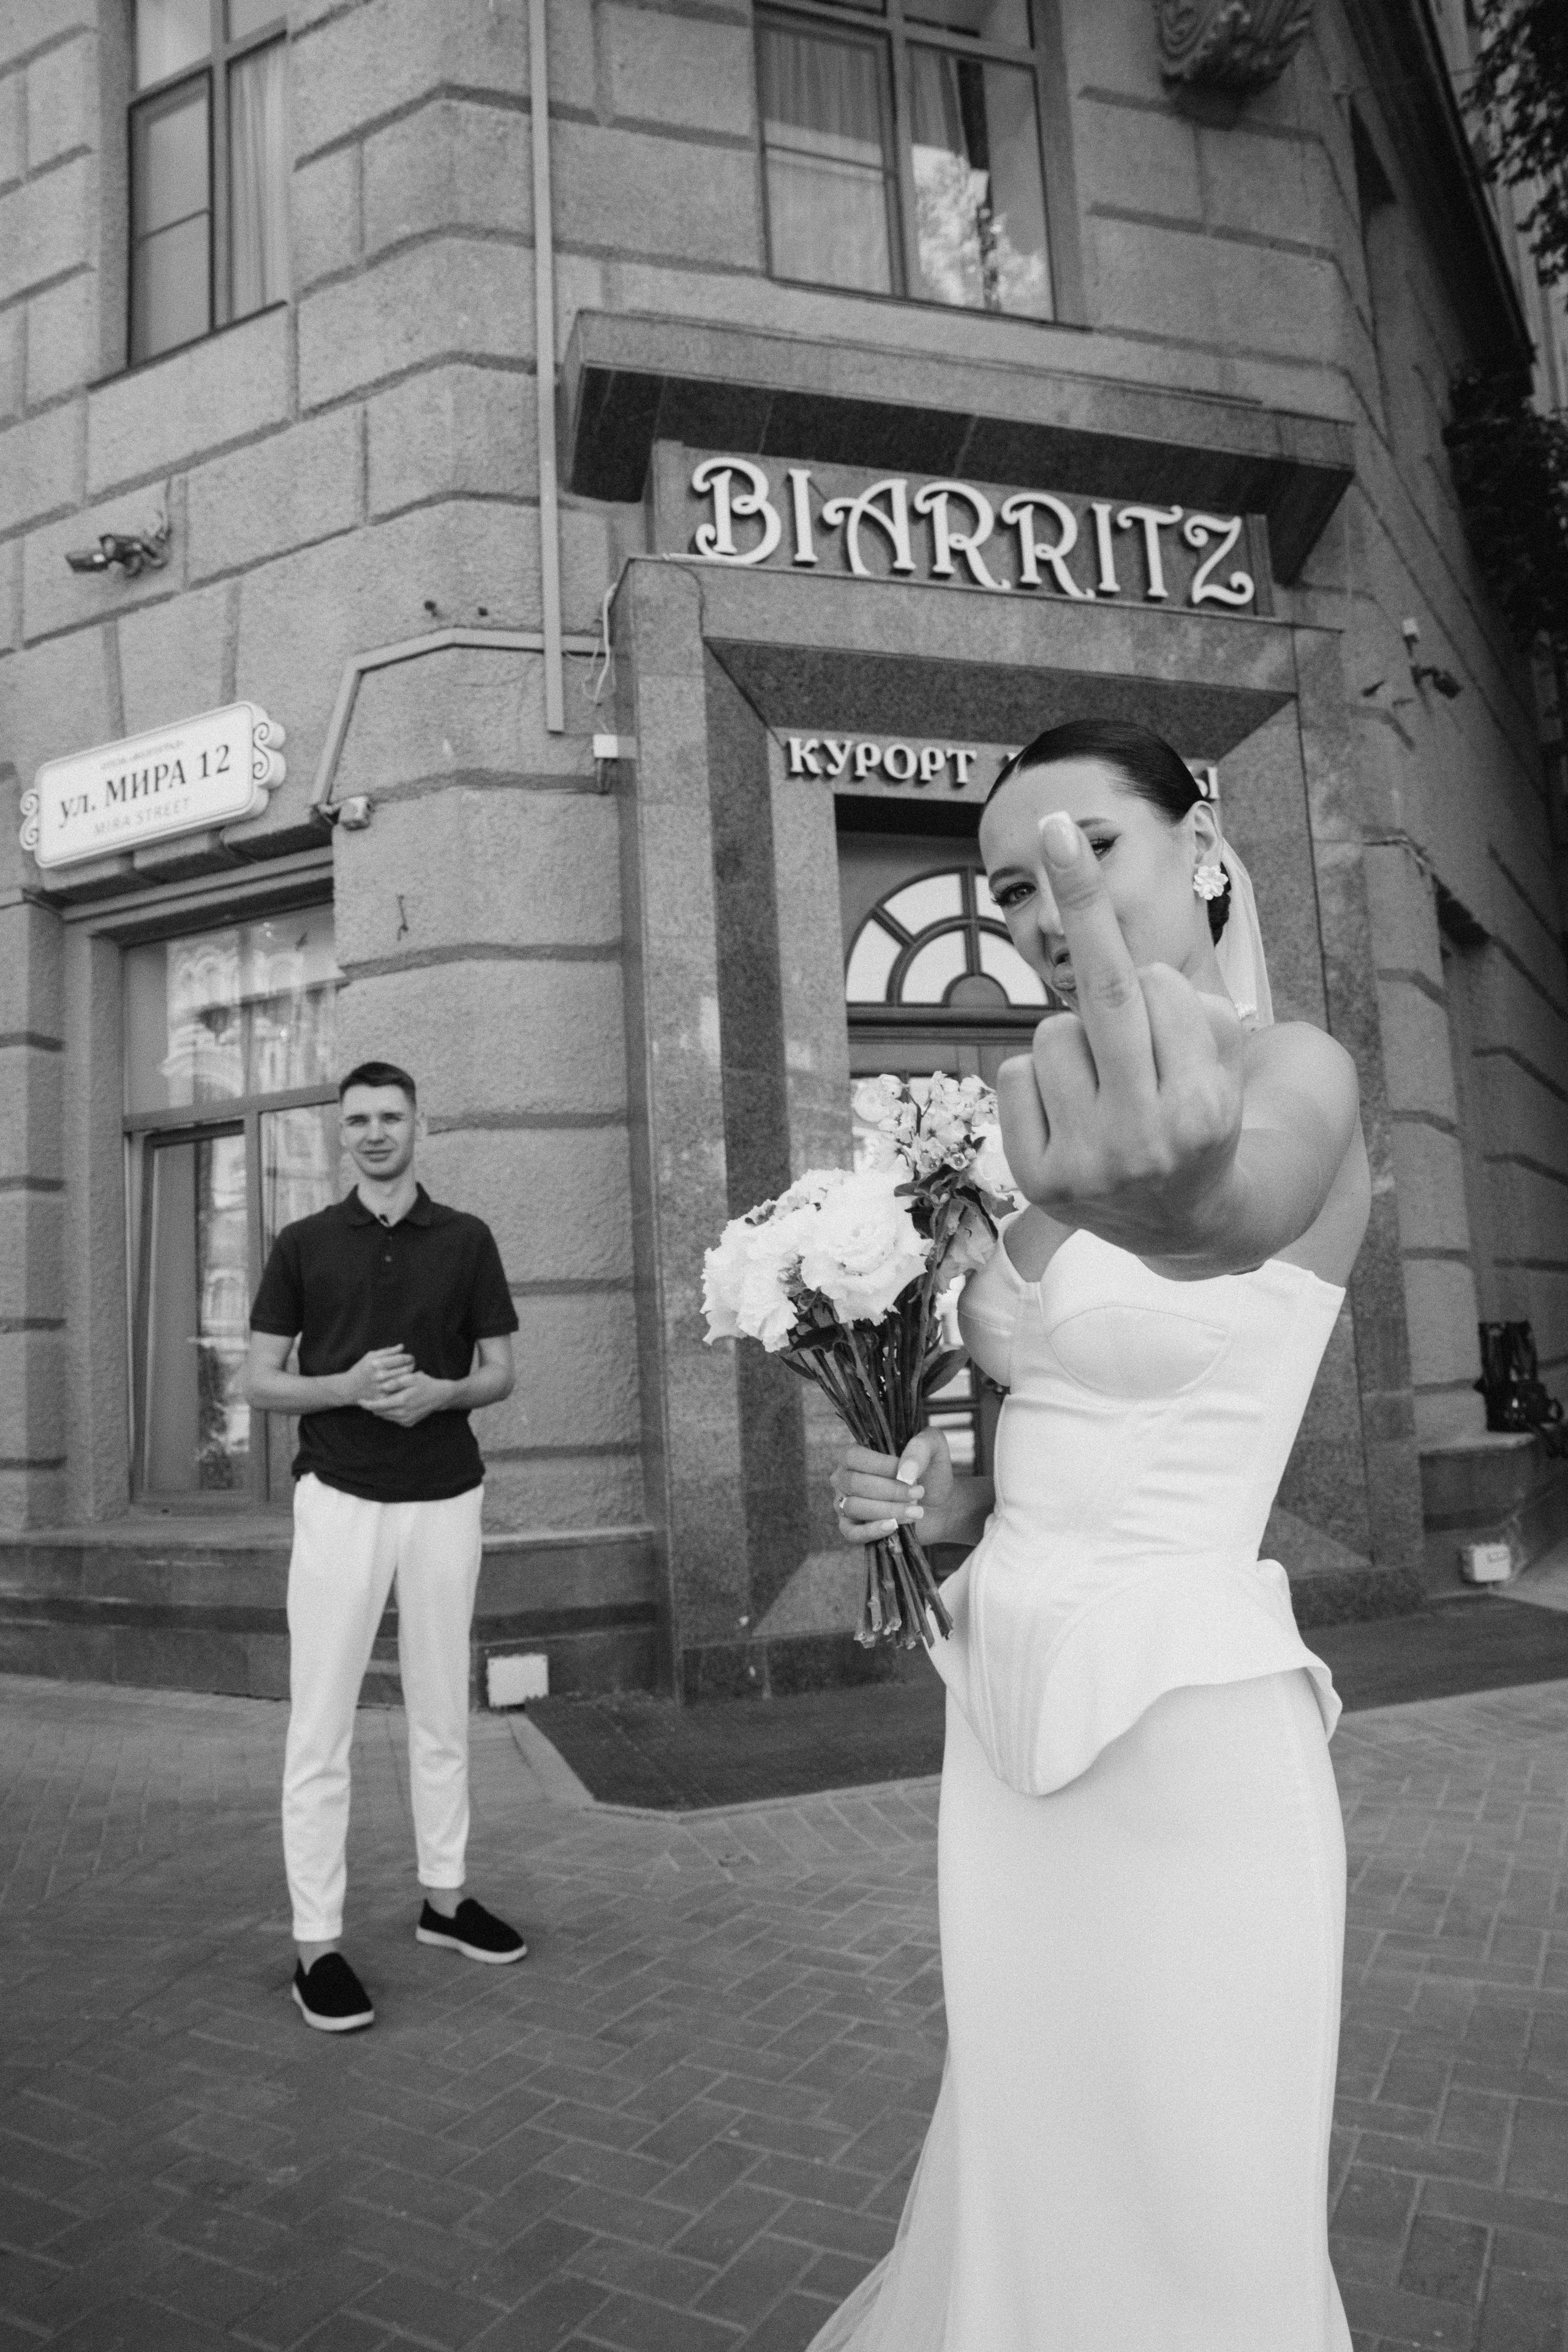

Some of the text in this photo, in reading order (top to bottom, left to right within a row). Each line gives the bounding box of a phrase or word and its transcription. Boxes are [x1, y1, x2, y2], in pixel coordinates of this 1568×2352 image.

[692, 457, 1254, 606] BIARRITZ
[58, 794, 96, 828] ул.
[105, 759, 186, 807] МИРА
[199, 743, 230, 780] 12
[788, 737, 978, 783] КУРОРТ
[93, 797, 189, 836] MIRA STREET
